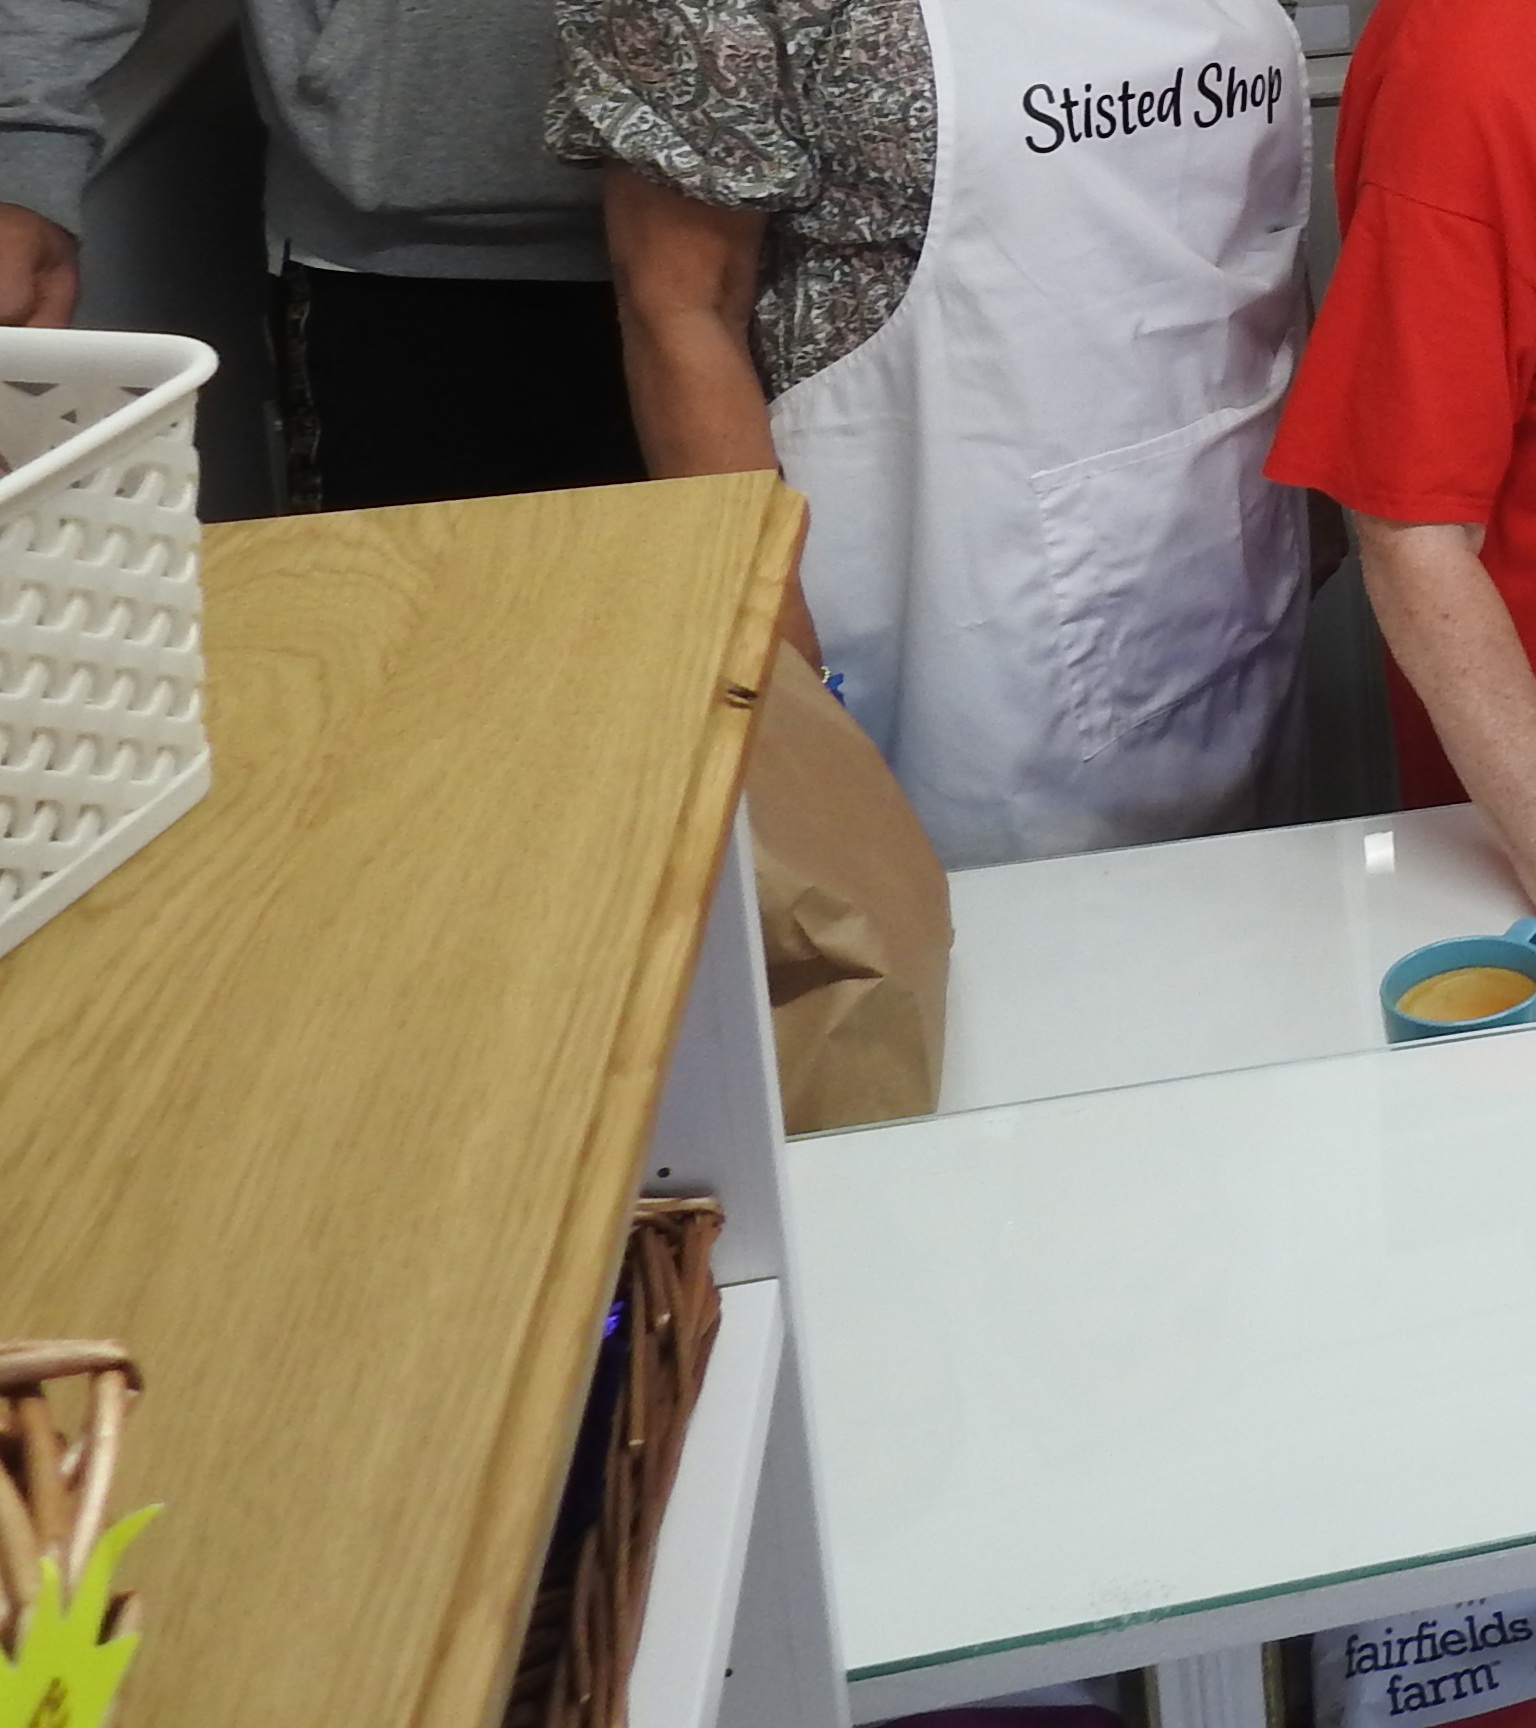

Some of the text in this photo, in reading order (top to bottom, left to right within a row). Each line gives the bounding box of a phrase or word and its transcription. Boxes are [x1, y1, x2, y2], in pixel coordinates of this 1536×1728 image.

[1023, 60, 1284, 155] Stisted Shop
[1343, 1610, 1534, 1679] fairfields
[1386, 1663, 1500, 1717] farm
